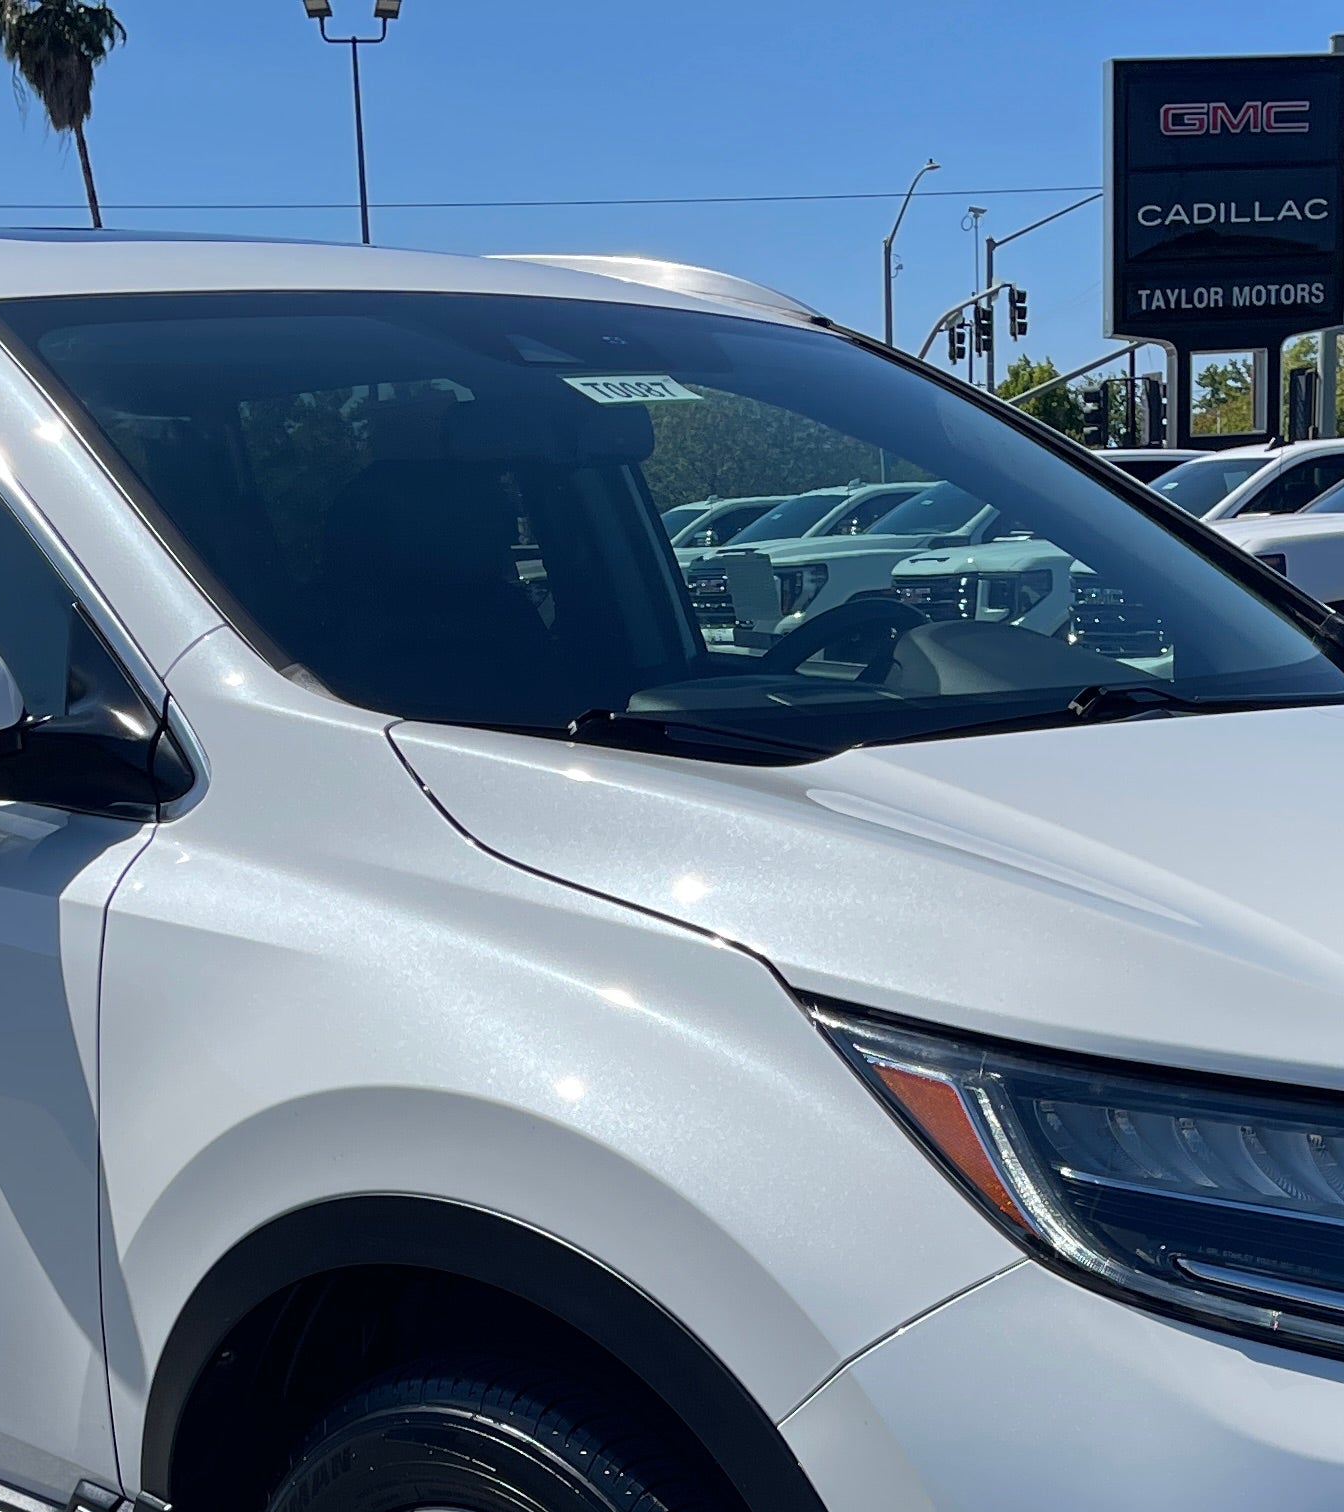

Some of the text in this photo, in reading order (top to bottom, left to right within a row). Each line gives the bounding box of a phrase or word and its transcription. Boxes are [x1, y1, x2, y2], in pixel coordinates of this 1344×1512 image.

[1160, 101, 1309, 135] GMC
[1137, 198, 1329, 226] CADILLAC
[1138, 283, 1325, 311] TAYLOR MOTORS
[580, 381, 678, 399] T0087
